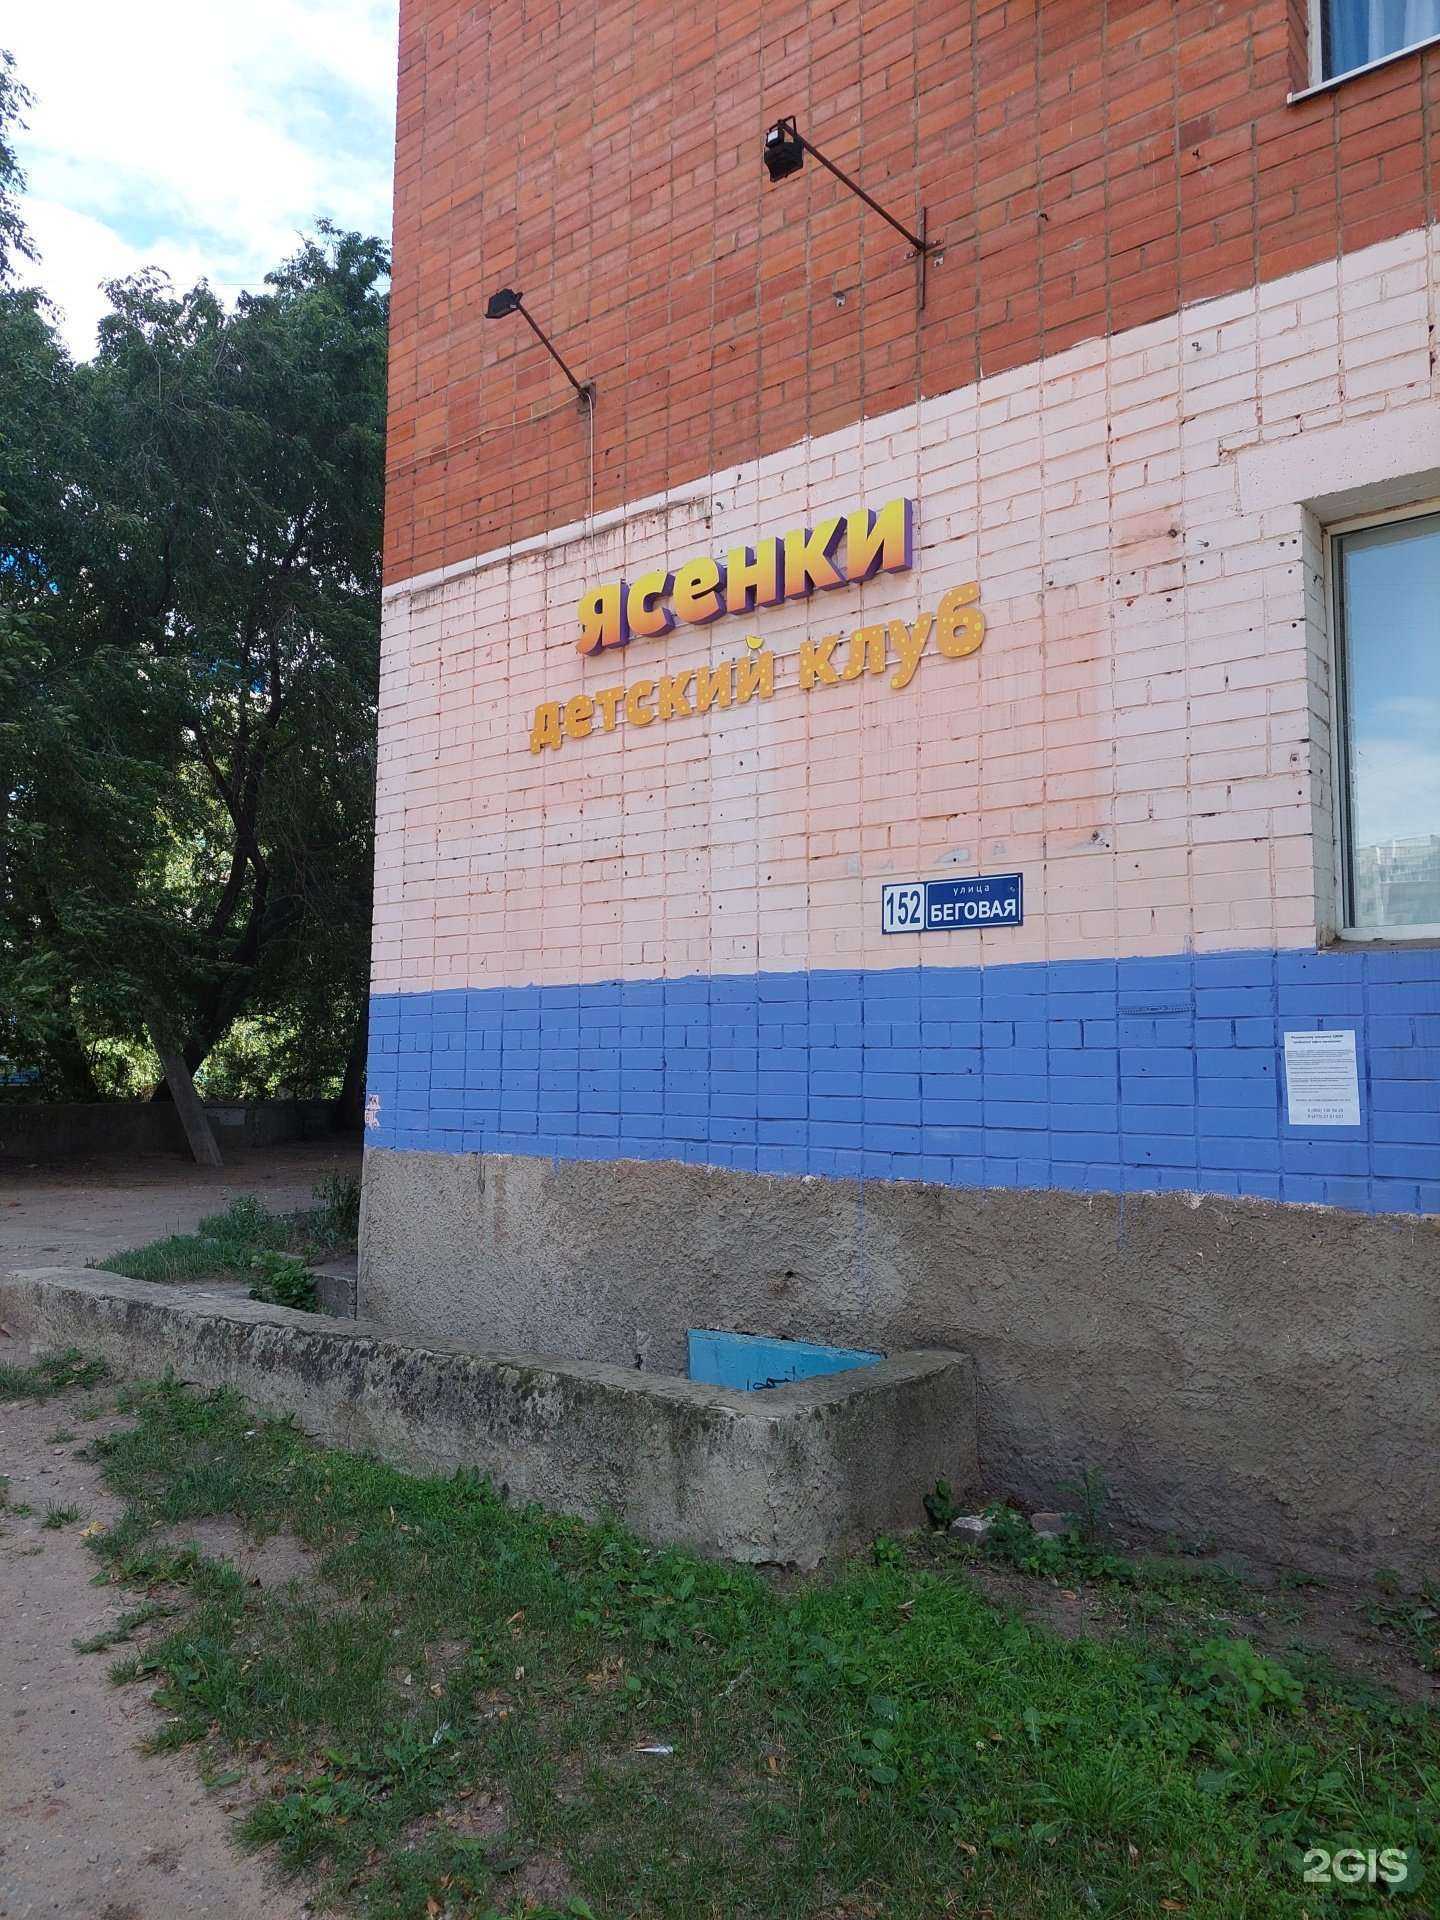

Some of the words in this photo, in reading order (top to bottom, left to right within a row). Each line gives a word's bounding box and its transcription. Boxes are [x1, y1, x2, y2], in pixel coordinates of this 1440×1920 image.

[530, 634, 775, 754] детский
[799, 582, 986, 690] клуб
[953, 885, 990, 897] улица
[886, 890, 921, 926] 152
[930, 898, 1017, 922] БЕГОВАЯ
